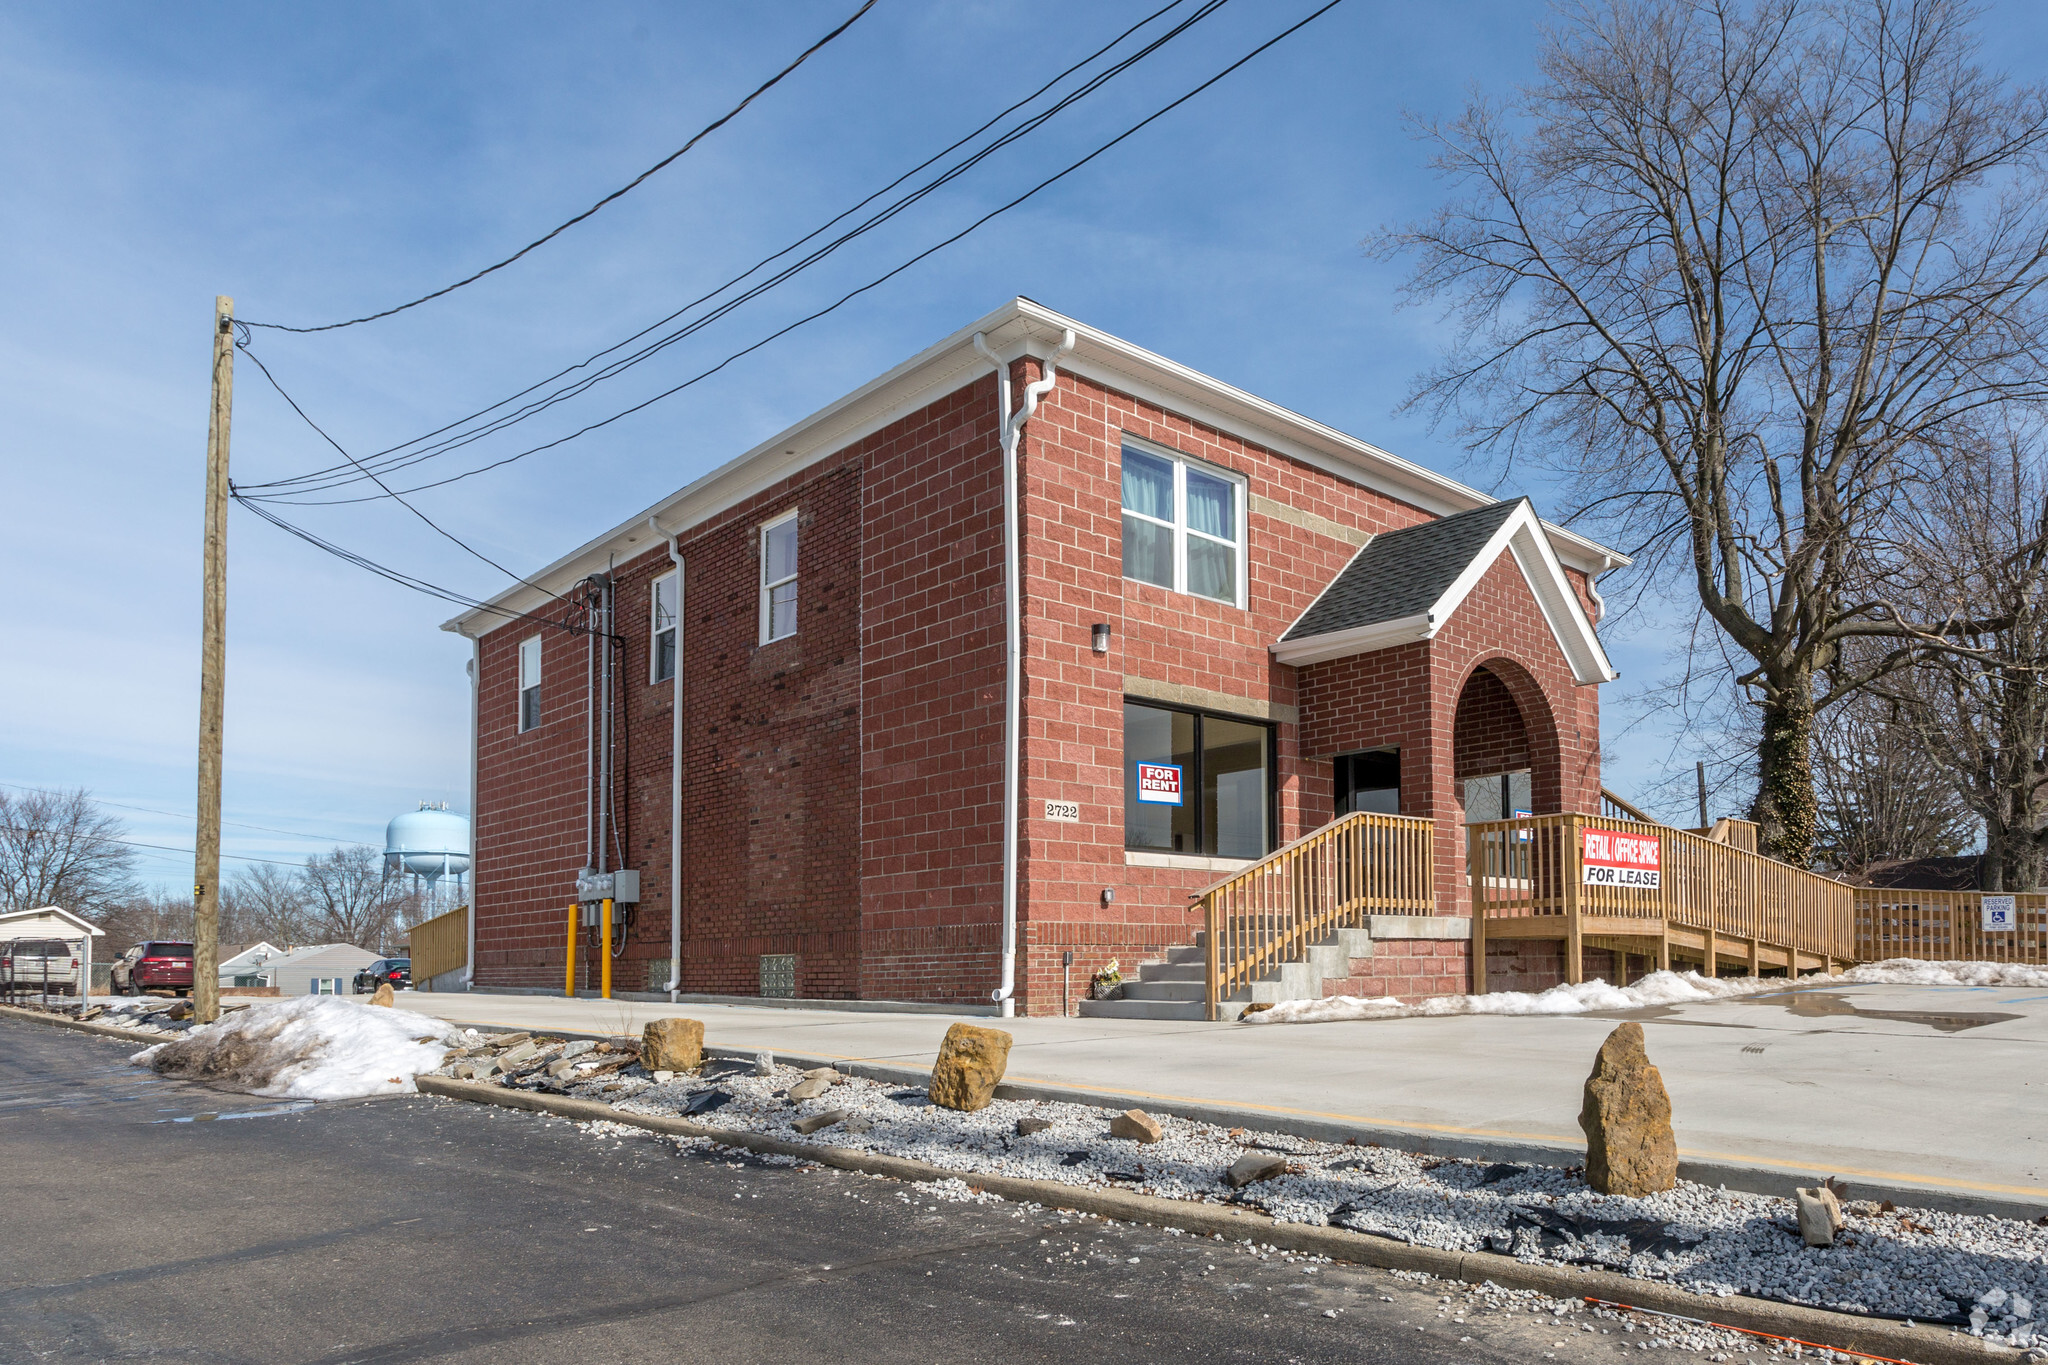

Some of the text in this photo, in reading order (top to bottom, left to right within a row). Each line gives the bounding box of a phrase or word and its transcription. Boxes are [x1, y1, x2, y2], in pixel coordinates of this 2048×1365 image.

[1146, 768, 1173, 780] FOR
[1142, 778, 1177, 791] RENT
[1046, 803, 1077, 818] 2722
[1585, 834, 1610, 860] RETAIL
[1615, 837, 1638, 863] OFFICE
[1639, 840, 1658, 865] SPACE
[1587, 867, 1658, 886] FOR LEASE
